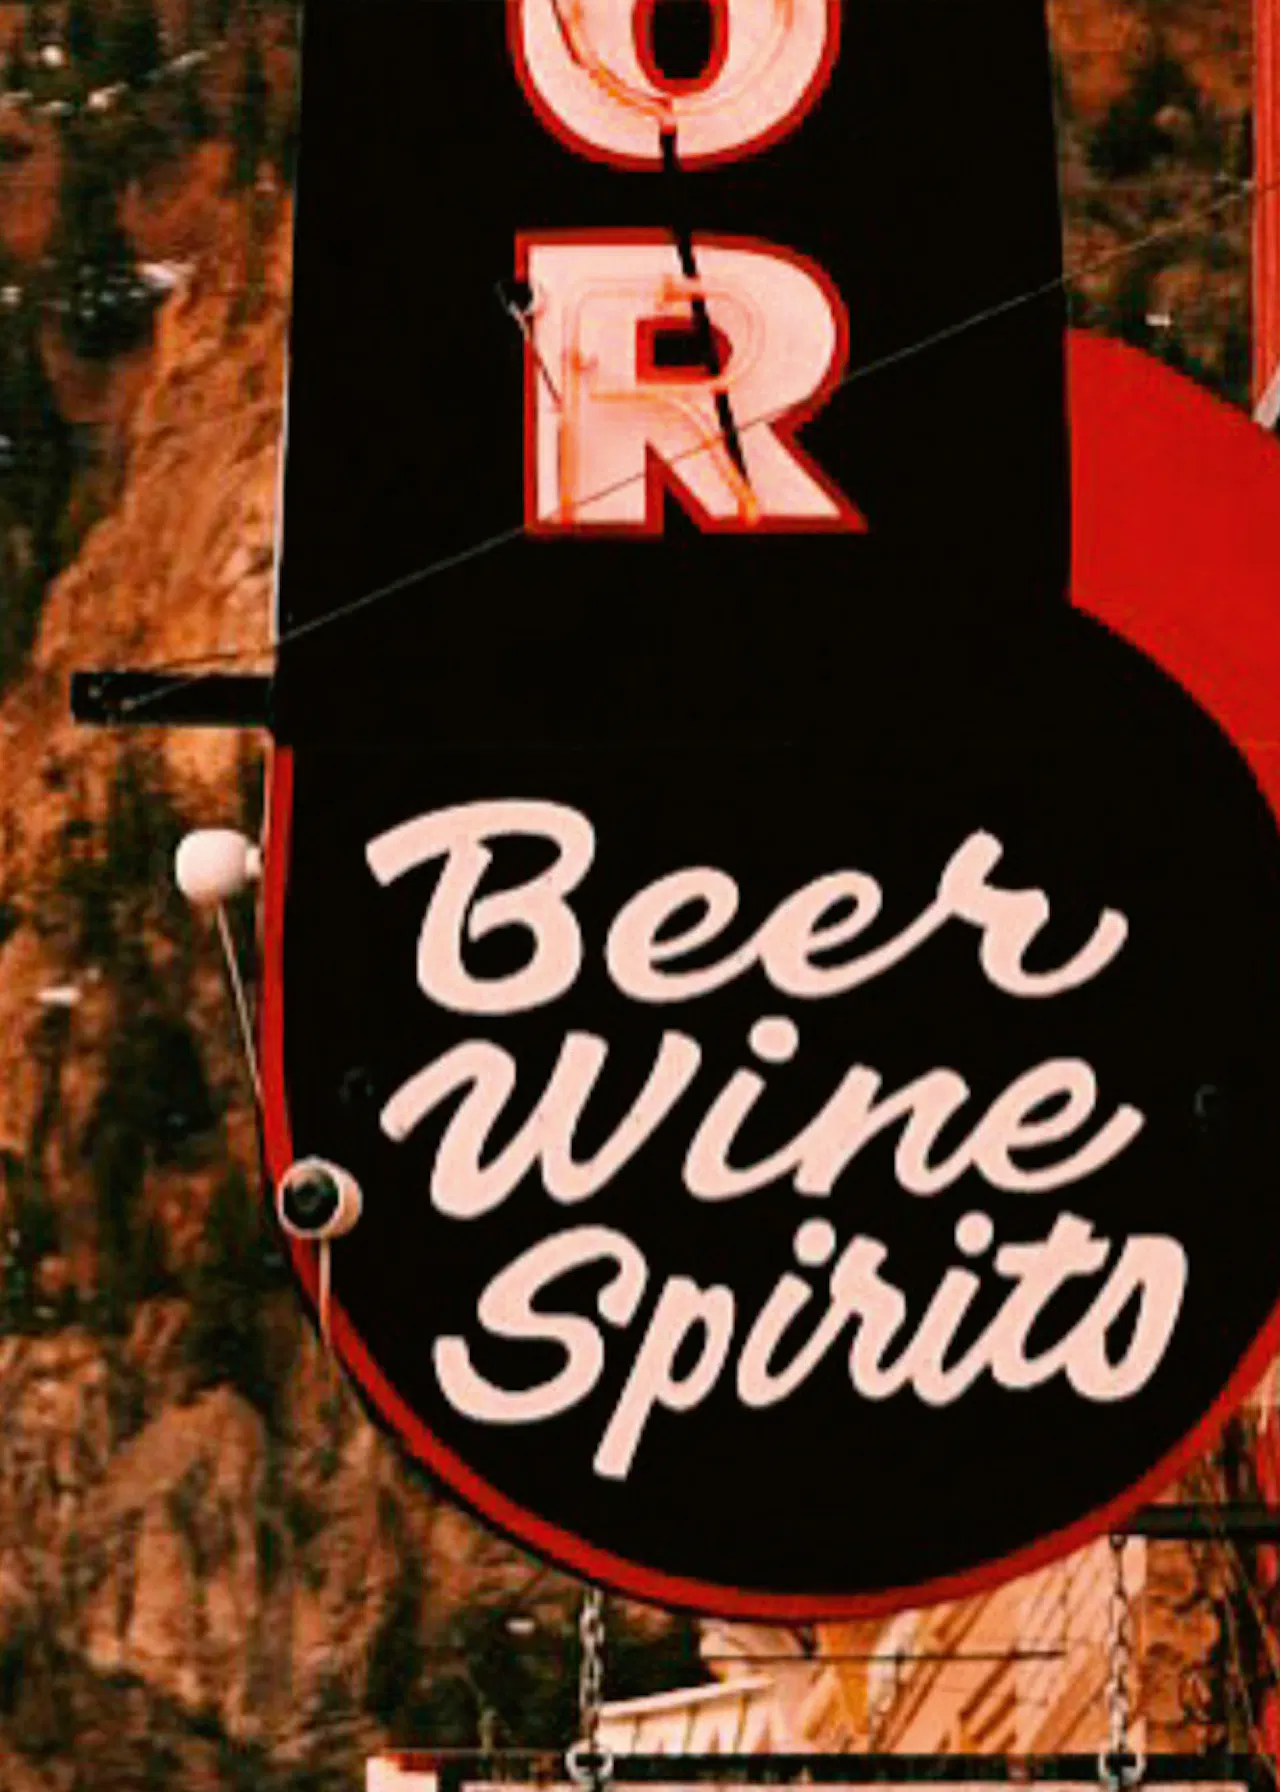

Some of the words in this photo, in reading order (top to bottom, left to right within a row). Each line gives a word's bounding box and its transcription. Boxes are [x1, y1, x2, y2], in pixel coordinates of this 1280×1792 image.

[364, 798, 1128, 1014] Beer
[379, 1017, 1145, 1218] Wine
[433, 1210, 1188, 1479] Spirits
